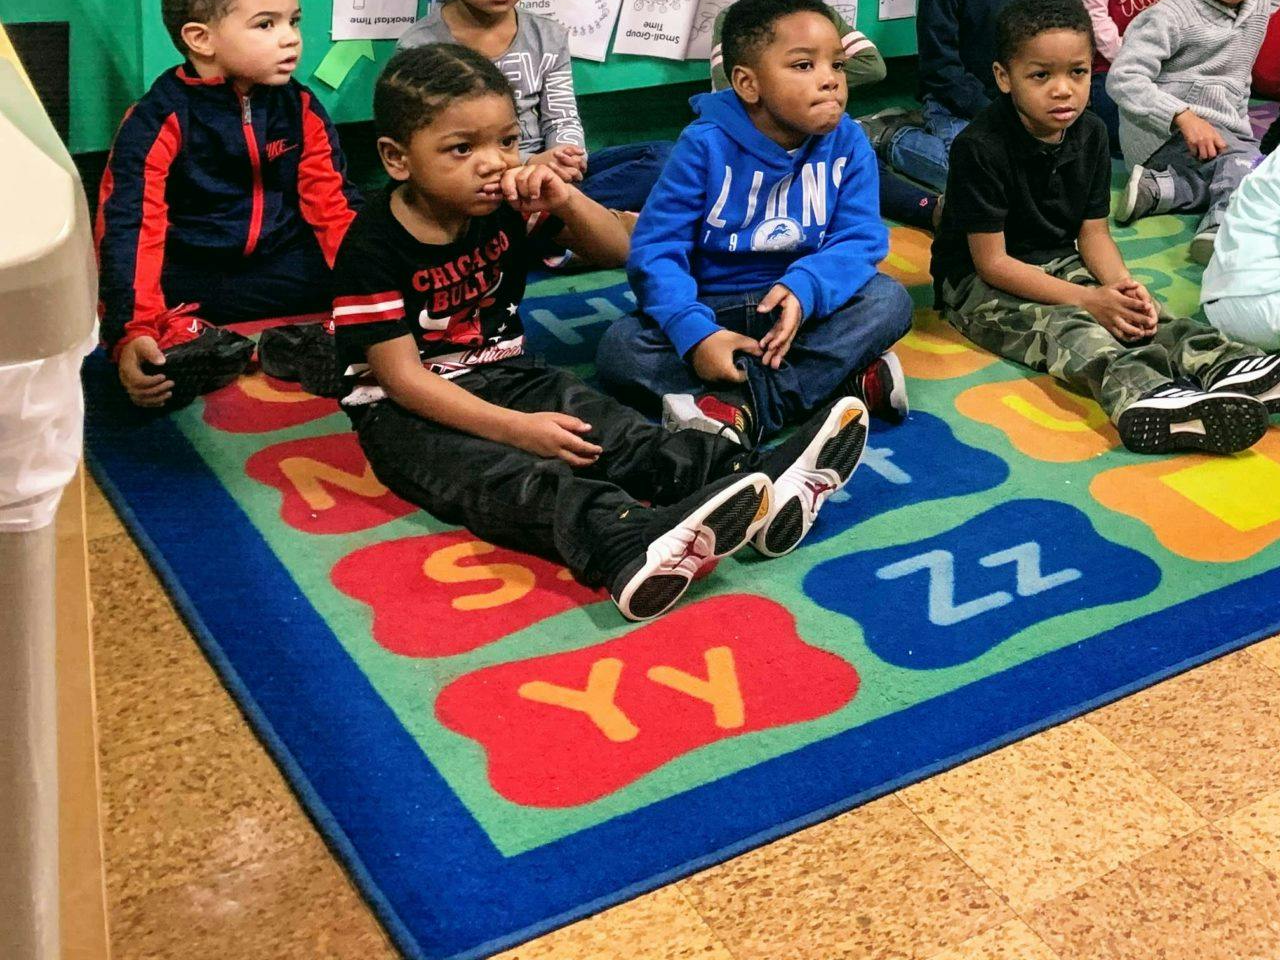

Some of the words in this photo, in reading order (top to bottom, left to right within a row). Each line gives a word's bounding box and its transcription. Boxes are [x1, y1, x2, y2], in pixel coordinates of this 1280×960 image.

[519, 0, 551, 10] hands
[350, 15, 372, 25] Time
[374, 14, 418, 25] Breakfast
[643, 21, 664, 32] Time
[625, 29, 680, 44] Small-Group
[411, 230, 510, 292] CHICAGO
